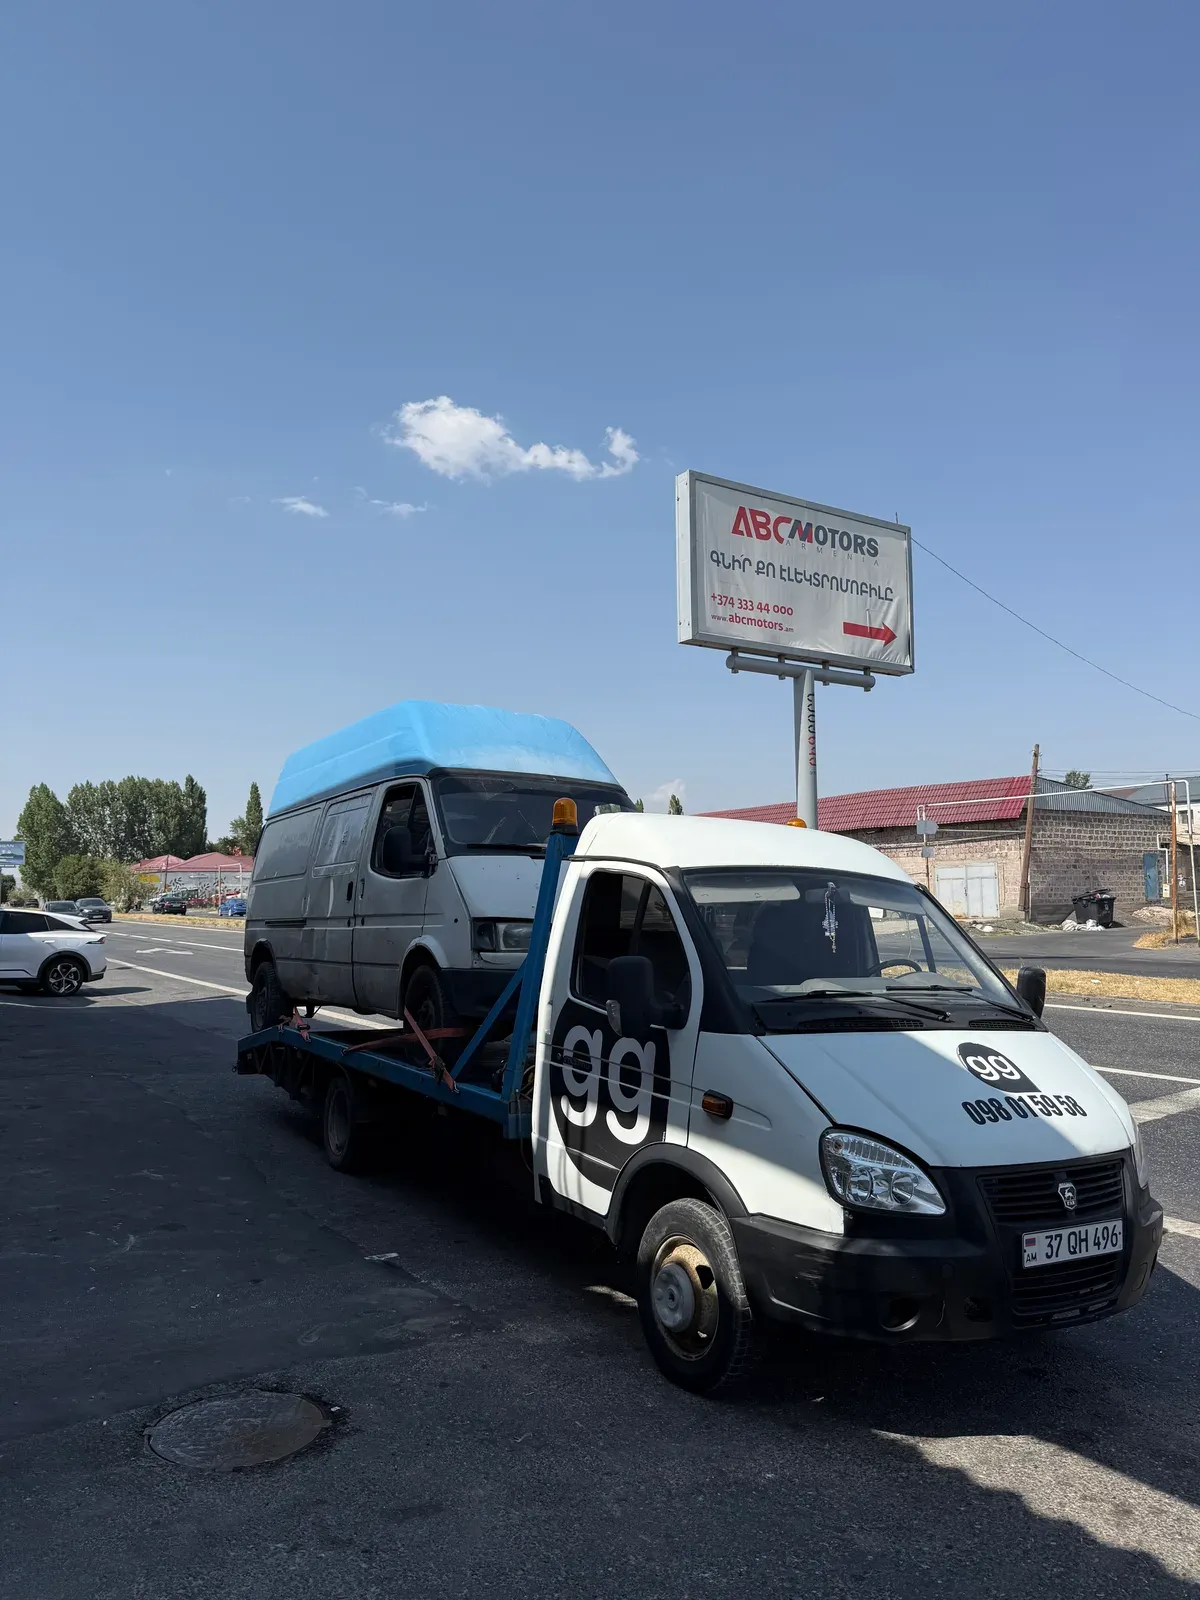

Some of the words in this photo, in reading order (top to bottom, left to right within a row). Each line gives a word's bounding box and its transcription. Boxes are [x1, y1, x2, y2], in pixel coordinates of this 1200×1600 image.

[731, 505, 879, 558] ABCMOTORS
[785, 539, 879, 567] ARMENIA
[711, 593, 735, 608] +374
[737, 598, 755, 611] 333
[756, 602, 770, 614] 44
[965, 1055, 1021, 1081] gg
[560, 1025, 656, 1145] gg
[961, 1098, 1012, 1125] 098
[1045, 1234, 1063, 1259] 37
[1067, 1229, 1089, 1255] QH
[1093, 1224, 1118, 1251] 496
[1025, 1252, 1037, 1263] AM
